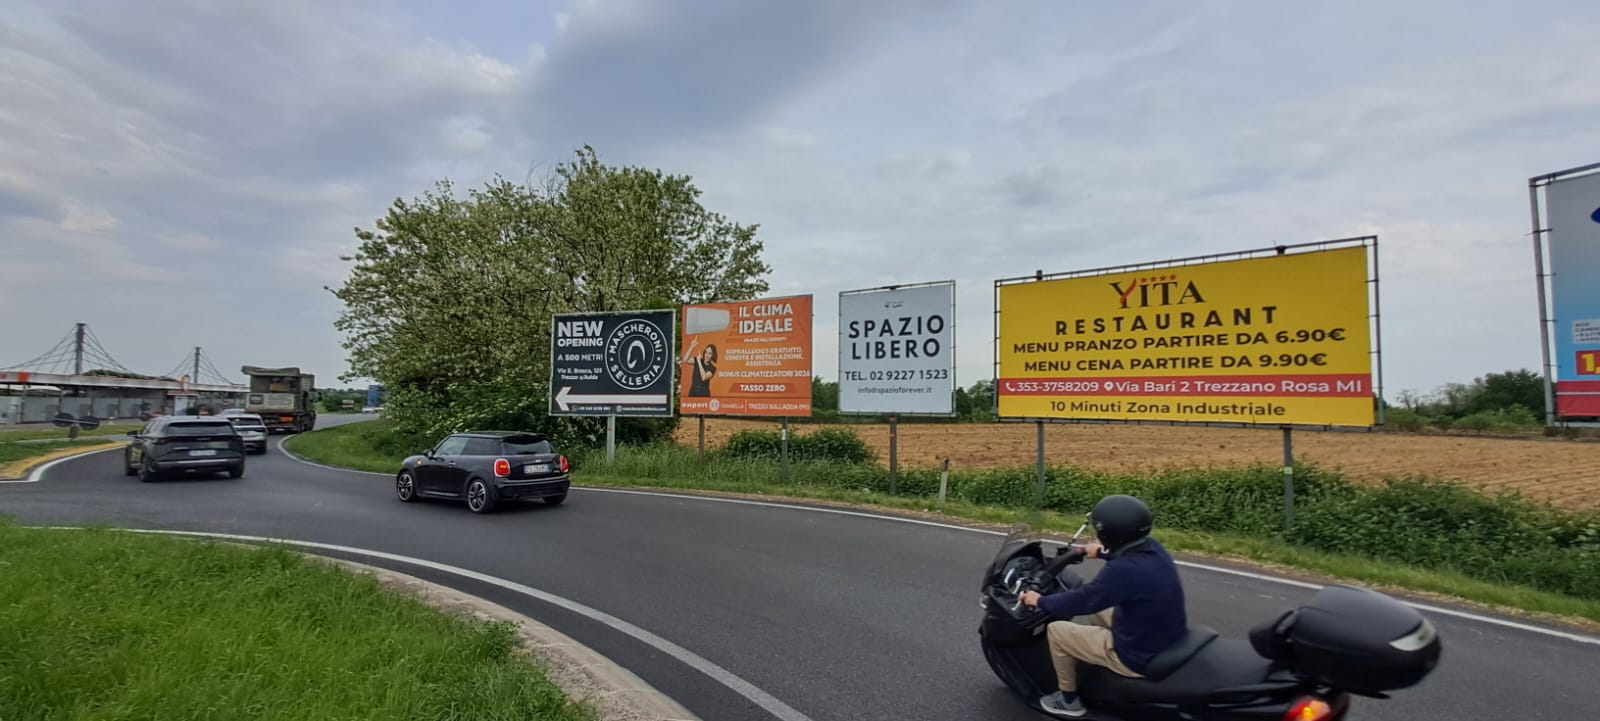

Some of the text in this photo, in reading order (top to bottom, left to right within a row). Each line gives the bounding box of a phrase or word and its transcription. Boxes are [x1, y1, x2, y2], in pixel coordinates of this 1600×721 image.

[1110, 278, 1206, 309] YITA
[739, 304, 793, 318] IL CLIMA
[1055, 306, 1277, 335] RESTAURANT
[558, 321, 603, 337] NEW
[739, 318, 792, 334] IDEALE
[848, 315, 944, 338] SPAZIO
[557, 338, 603, 347] OPENING
[609, 324, 663, 354] MASCHERONI
[1013, 328, 1346, 353] MENU PRANZO PARTIRE DA 6.90€
[852, 338, 940, 360] LIBERO
[1024, 353, 1327, 372] MENU CENA PARTIRE DA 9.90€
[611, 364, 660, 385] SELLERIA
[845, 369, 948, 380] TEL. 02 9227 1523
[1017, 380, 1362, 392] 353-3758209 Via Bari 2 Trezzano Rosa MI
[1050, 401, 1286, 416] 10 Minuti Zona Industriale
